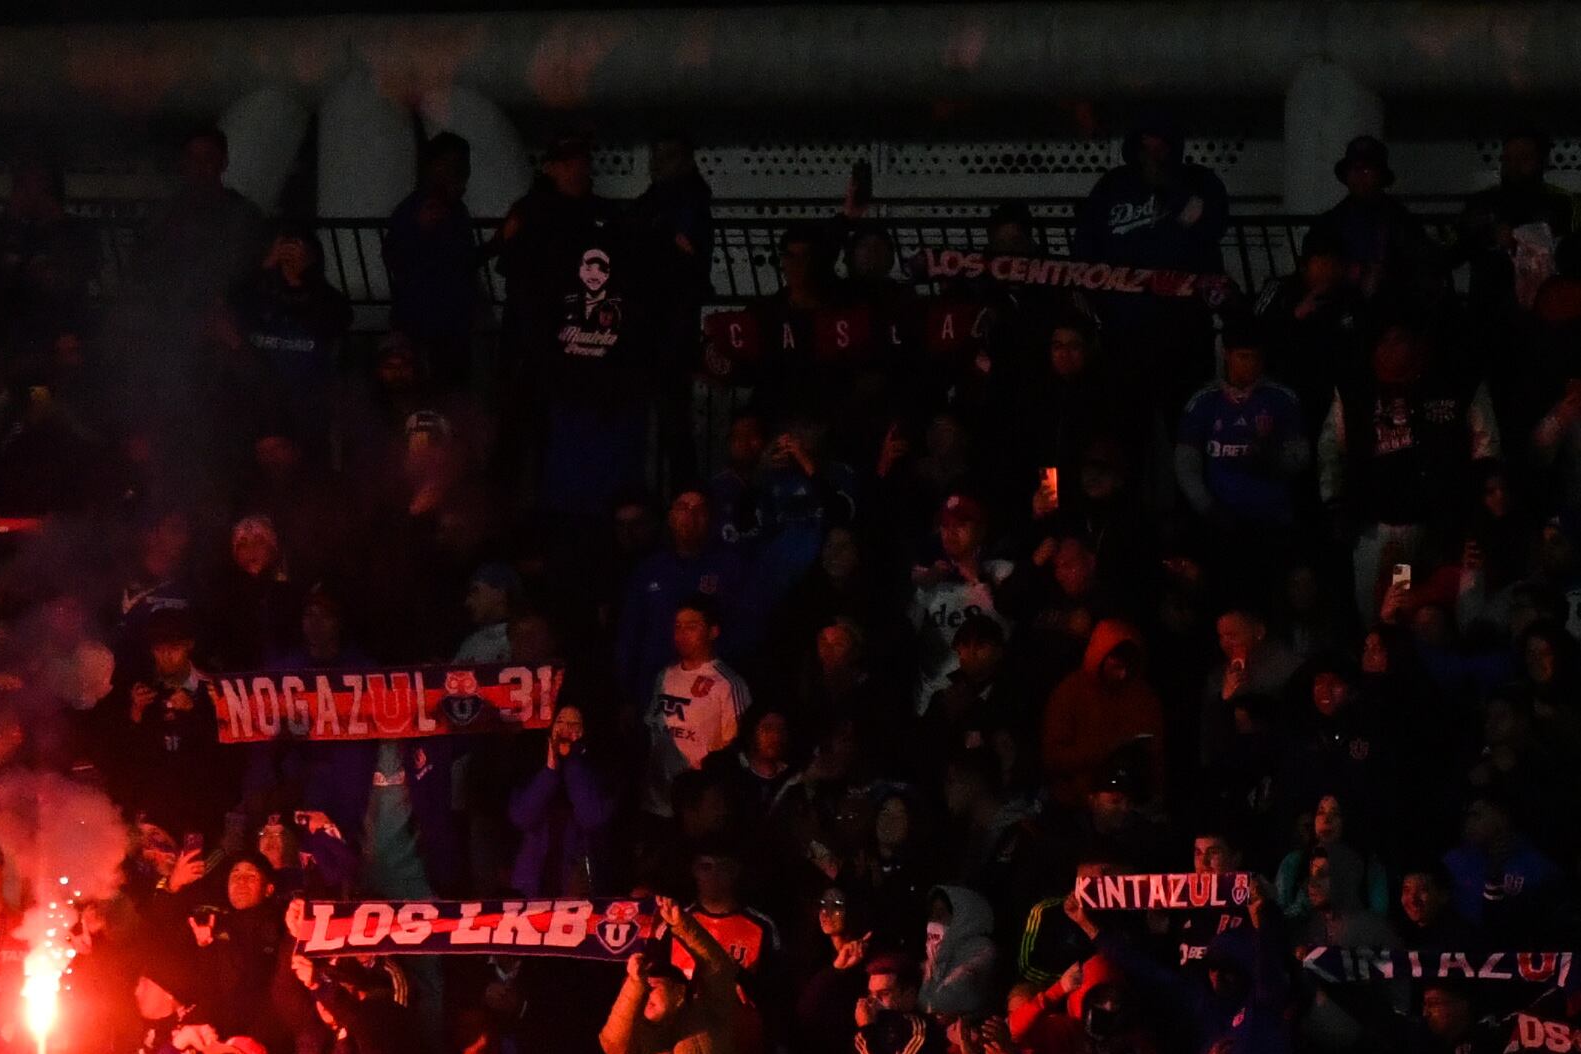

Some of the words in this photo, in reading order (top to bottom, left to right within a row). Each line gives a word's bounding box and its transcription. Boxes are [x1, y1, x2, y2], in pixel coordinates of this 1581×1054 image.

[221, 671, 437, 737] NOGAZUL
[1075, 872, 1227, 909] KINTAZUL
[304, 903, 440, 952] LOS
[450, 900, 594, 948] LKB
